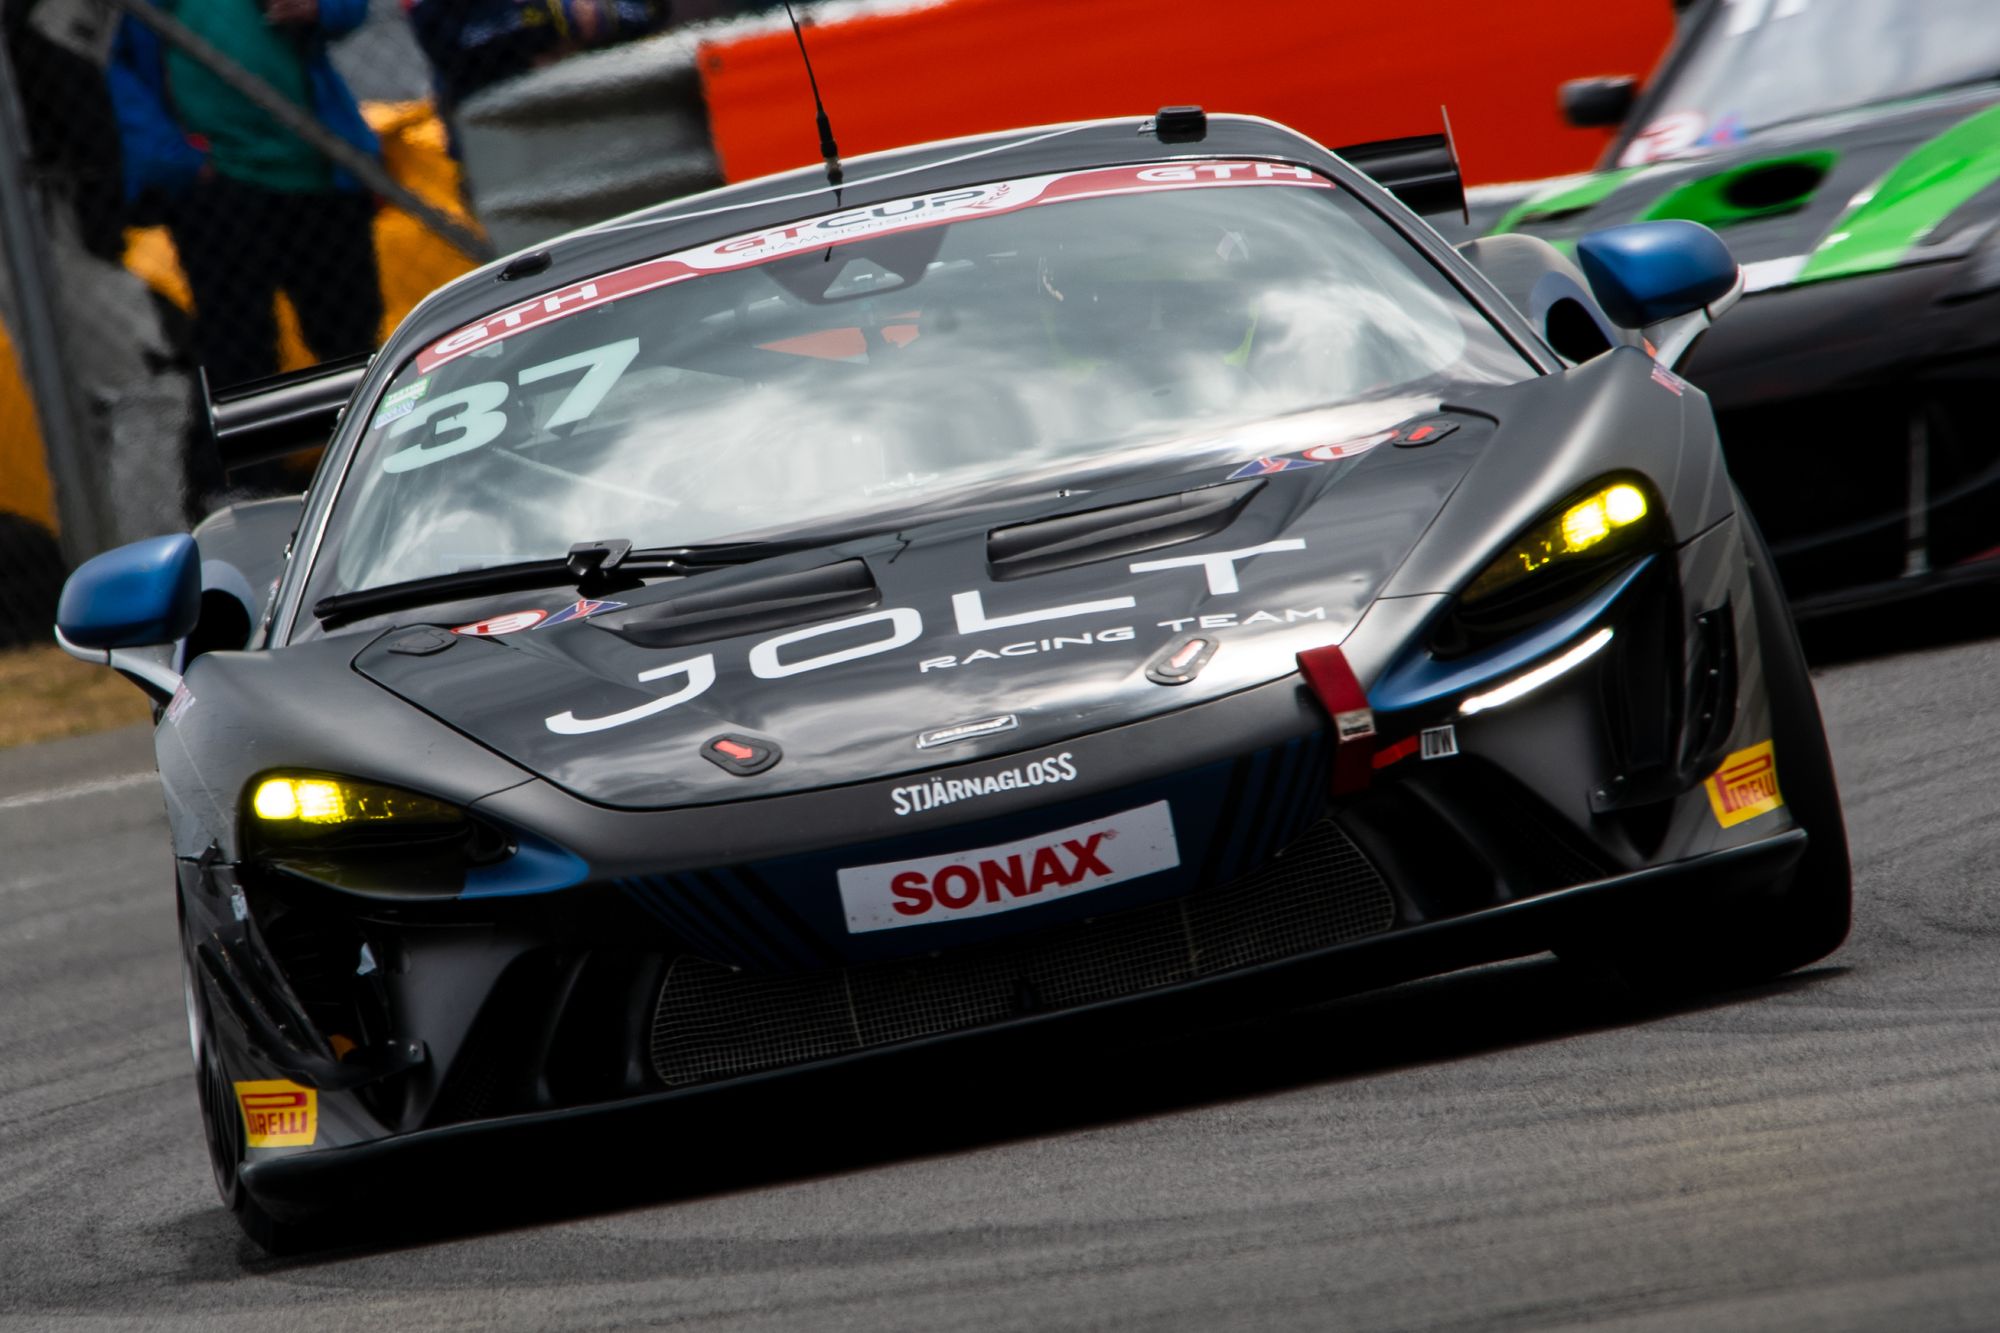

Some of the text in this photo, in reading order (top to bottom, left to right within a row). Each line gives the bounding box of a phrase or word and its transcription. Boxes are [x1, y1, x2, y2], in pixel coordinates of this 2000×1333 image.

[1136, 164, 1313, 182] GTH
[435, 283, 598, 354] GTH
[383, 338, 640, 474] 37
[545, 538, 1306, 735] JOLT
[919, 606, 1326, 673] RACING TEAM
[891, 752, 1077, 816] STJÄRNAGLOSS
